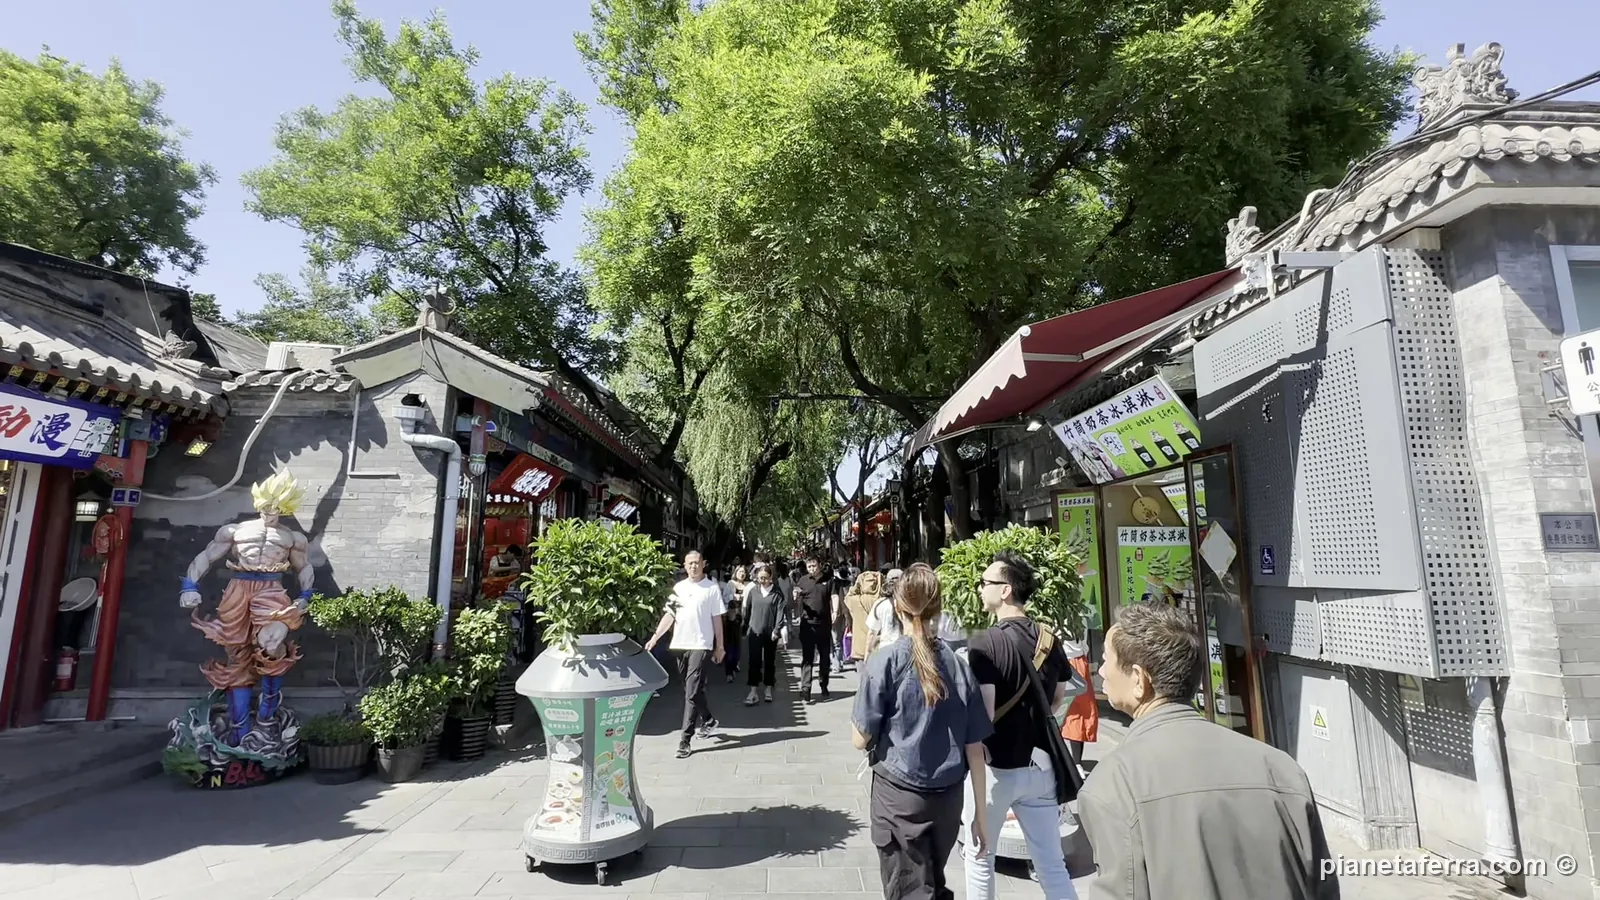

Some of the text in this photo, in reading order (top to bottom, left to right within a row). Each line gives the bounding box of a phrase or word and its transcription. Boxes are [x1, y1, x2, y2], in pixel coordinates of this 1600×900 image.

[1062, 388, 1156, 440] 竹筒奶茶冰淇淋
[1120, 529, 1187, 543] 竹筒奶茶冰淇淋
